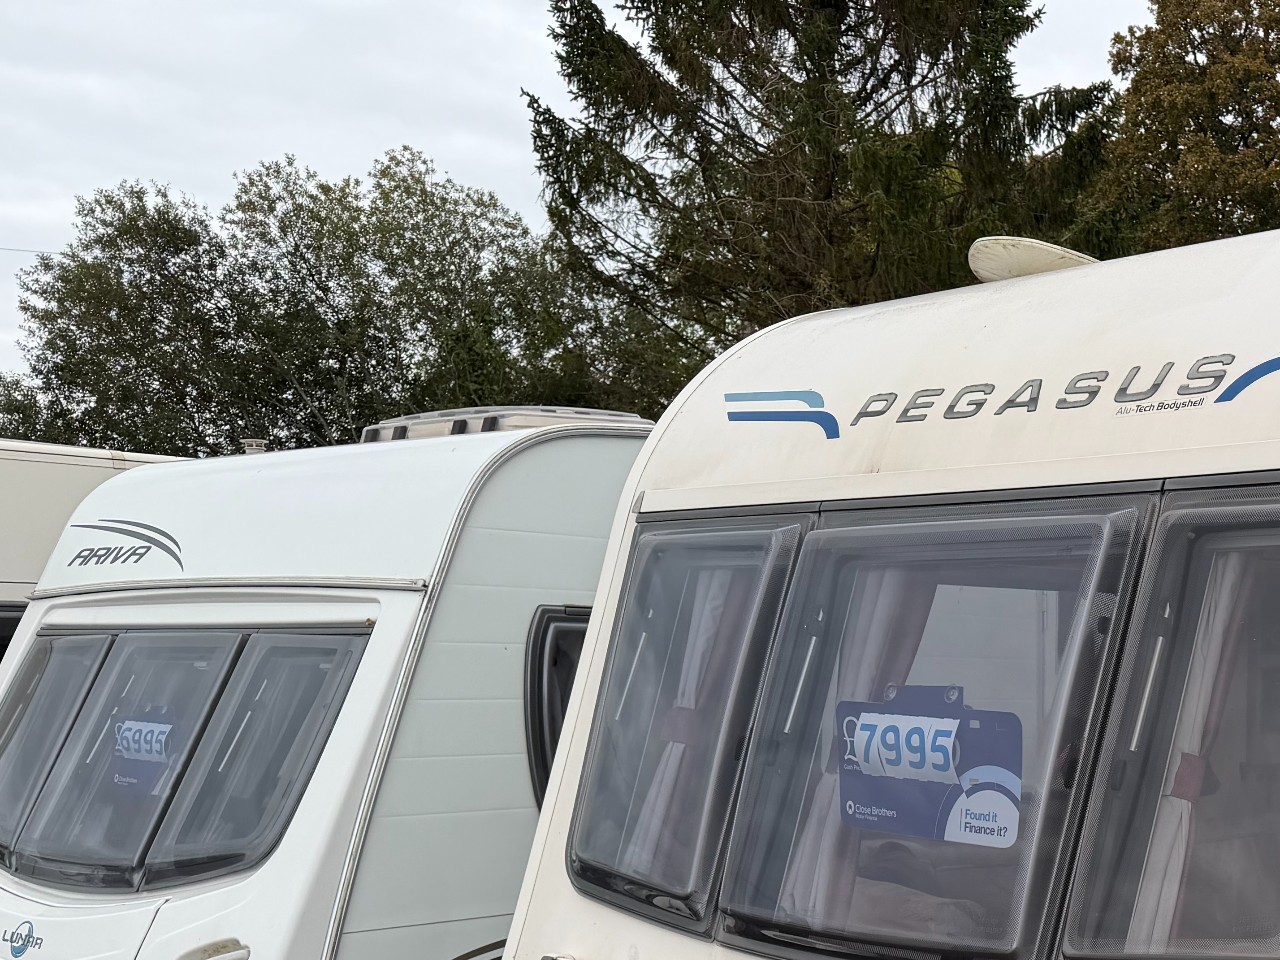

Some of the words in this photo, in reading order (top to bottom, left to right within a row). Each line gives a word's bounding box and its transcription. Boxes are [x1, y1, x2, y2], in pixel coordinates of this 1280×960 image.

[849, 353, 1236, 427] PEGASUS
[1115, 402, 1155, 416] Alu-Tech
[1156, 397, 1205, 412] Bodyshell
[67, 545, 152, 567] ARIVA
[855, 804, 871, 815] Close
[872, 806, 897, 818] Brothers
[964, 808, 991, 823] Found
[991, 811, 998, 823] it
[964, 822, 996, 836] Finance
[996, 825, 1008, 838] it?
[2, 929, 44, 949] LUNAR
